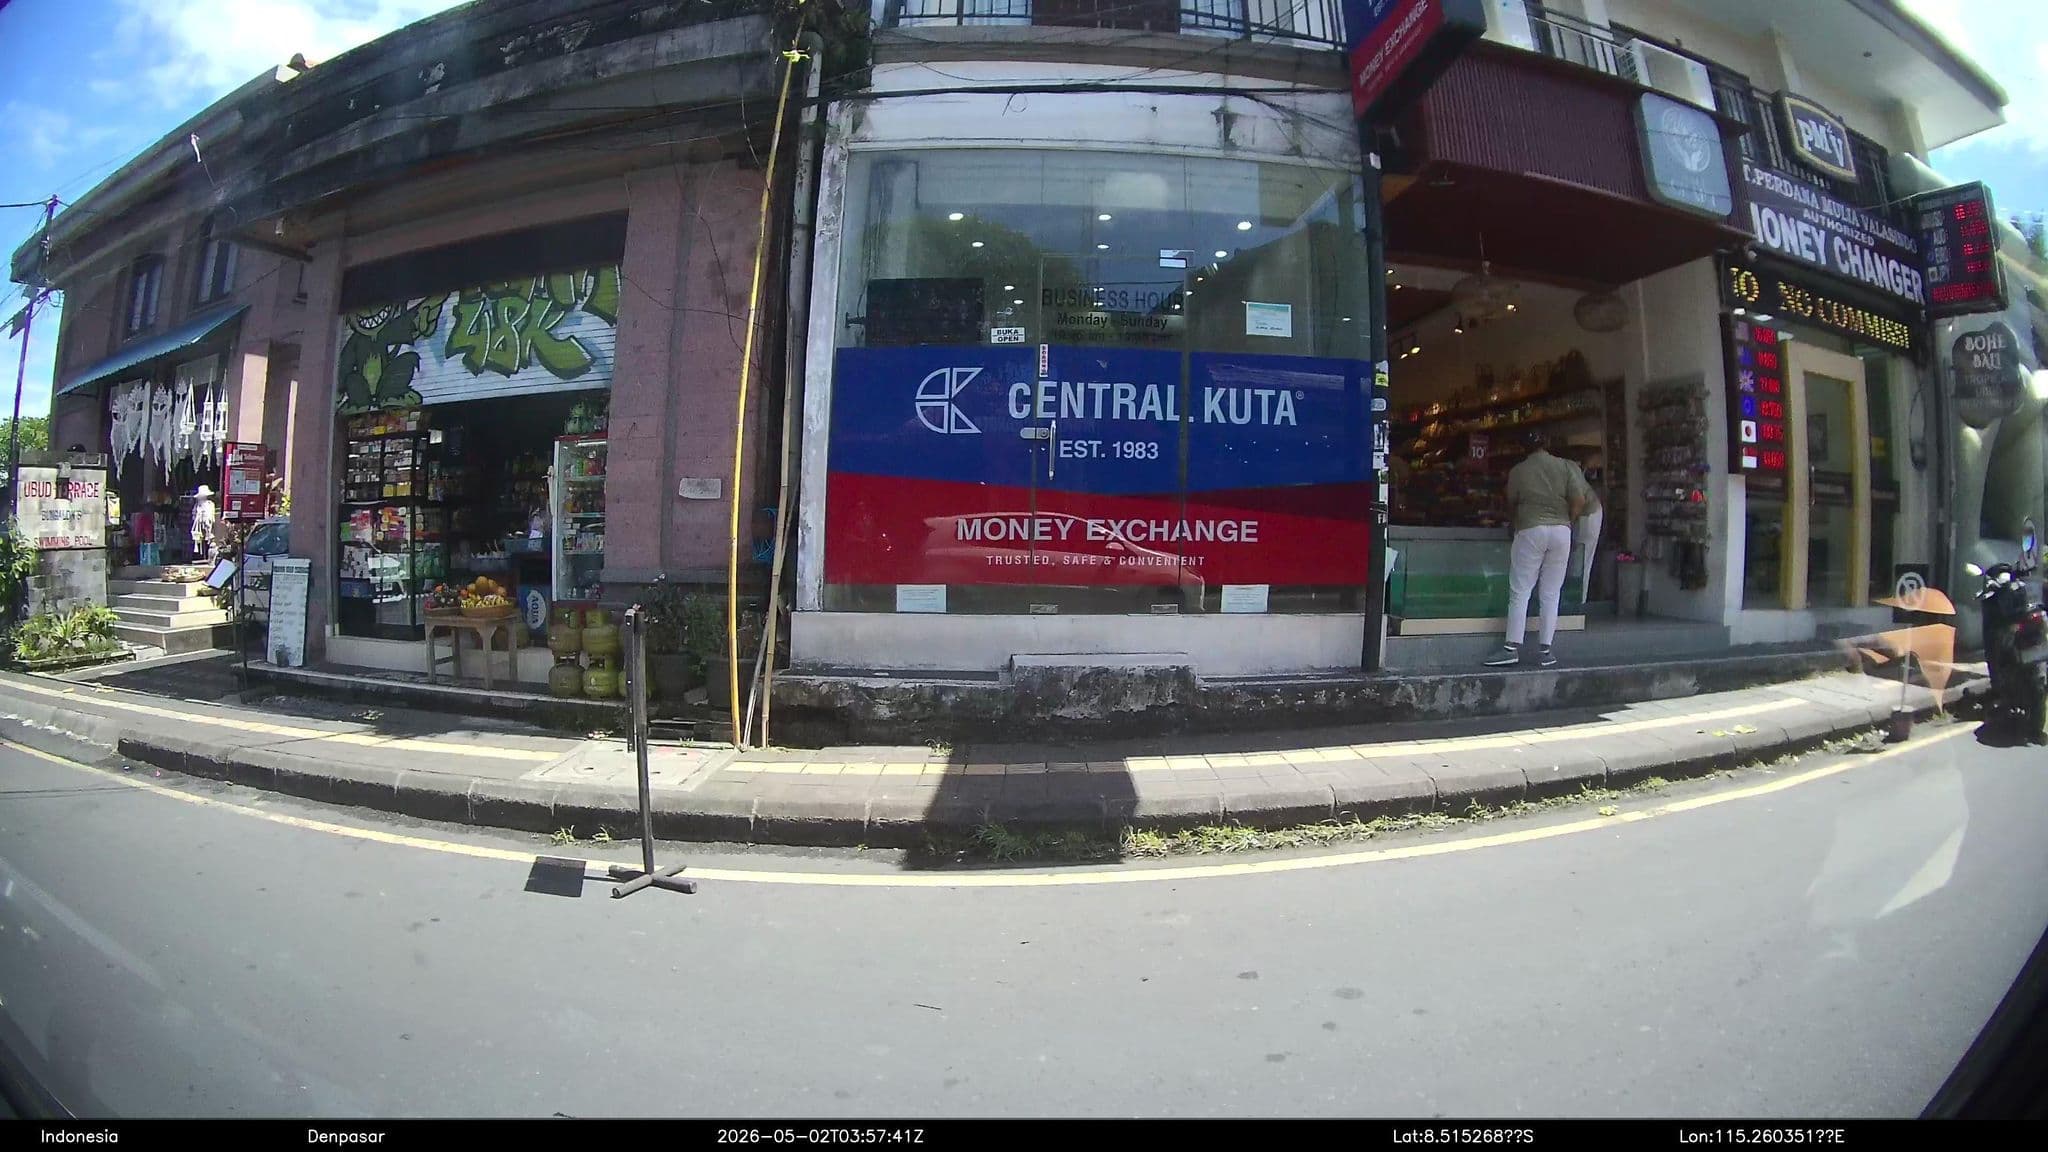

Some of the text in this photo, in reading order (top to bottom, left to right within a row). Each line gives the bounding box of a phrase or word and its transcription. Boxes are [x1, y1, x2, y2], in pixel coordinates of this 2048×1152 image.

[1360, 48, 1384, 88] MONEY
[1802, 207, 1875, 248] AUTHORIZED
[1833, 235, 1927, 307] CHANGER
[1042, 288, 1129, 309] BUSINESS
[1057, 311, 1108, 328] Monday
[1120, 314, 1168, 330] Sunday
[1059, 440, 1159, 459] EST. 1983
[24, 481, 52, 498] UBUD
[74, 535, 94, 546] POOL
[957, 518, 1259, 543] MONEY EXCHANGE
[986, 555, 1204, 567] TRUSTED, SAFE & CONVENIENT
[531, 594, 540, 625] AQUA
